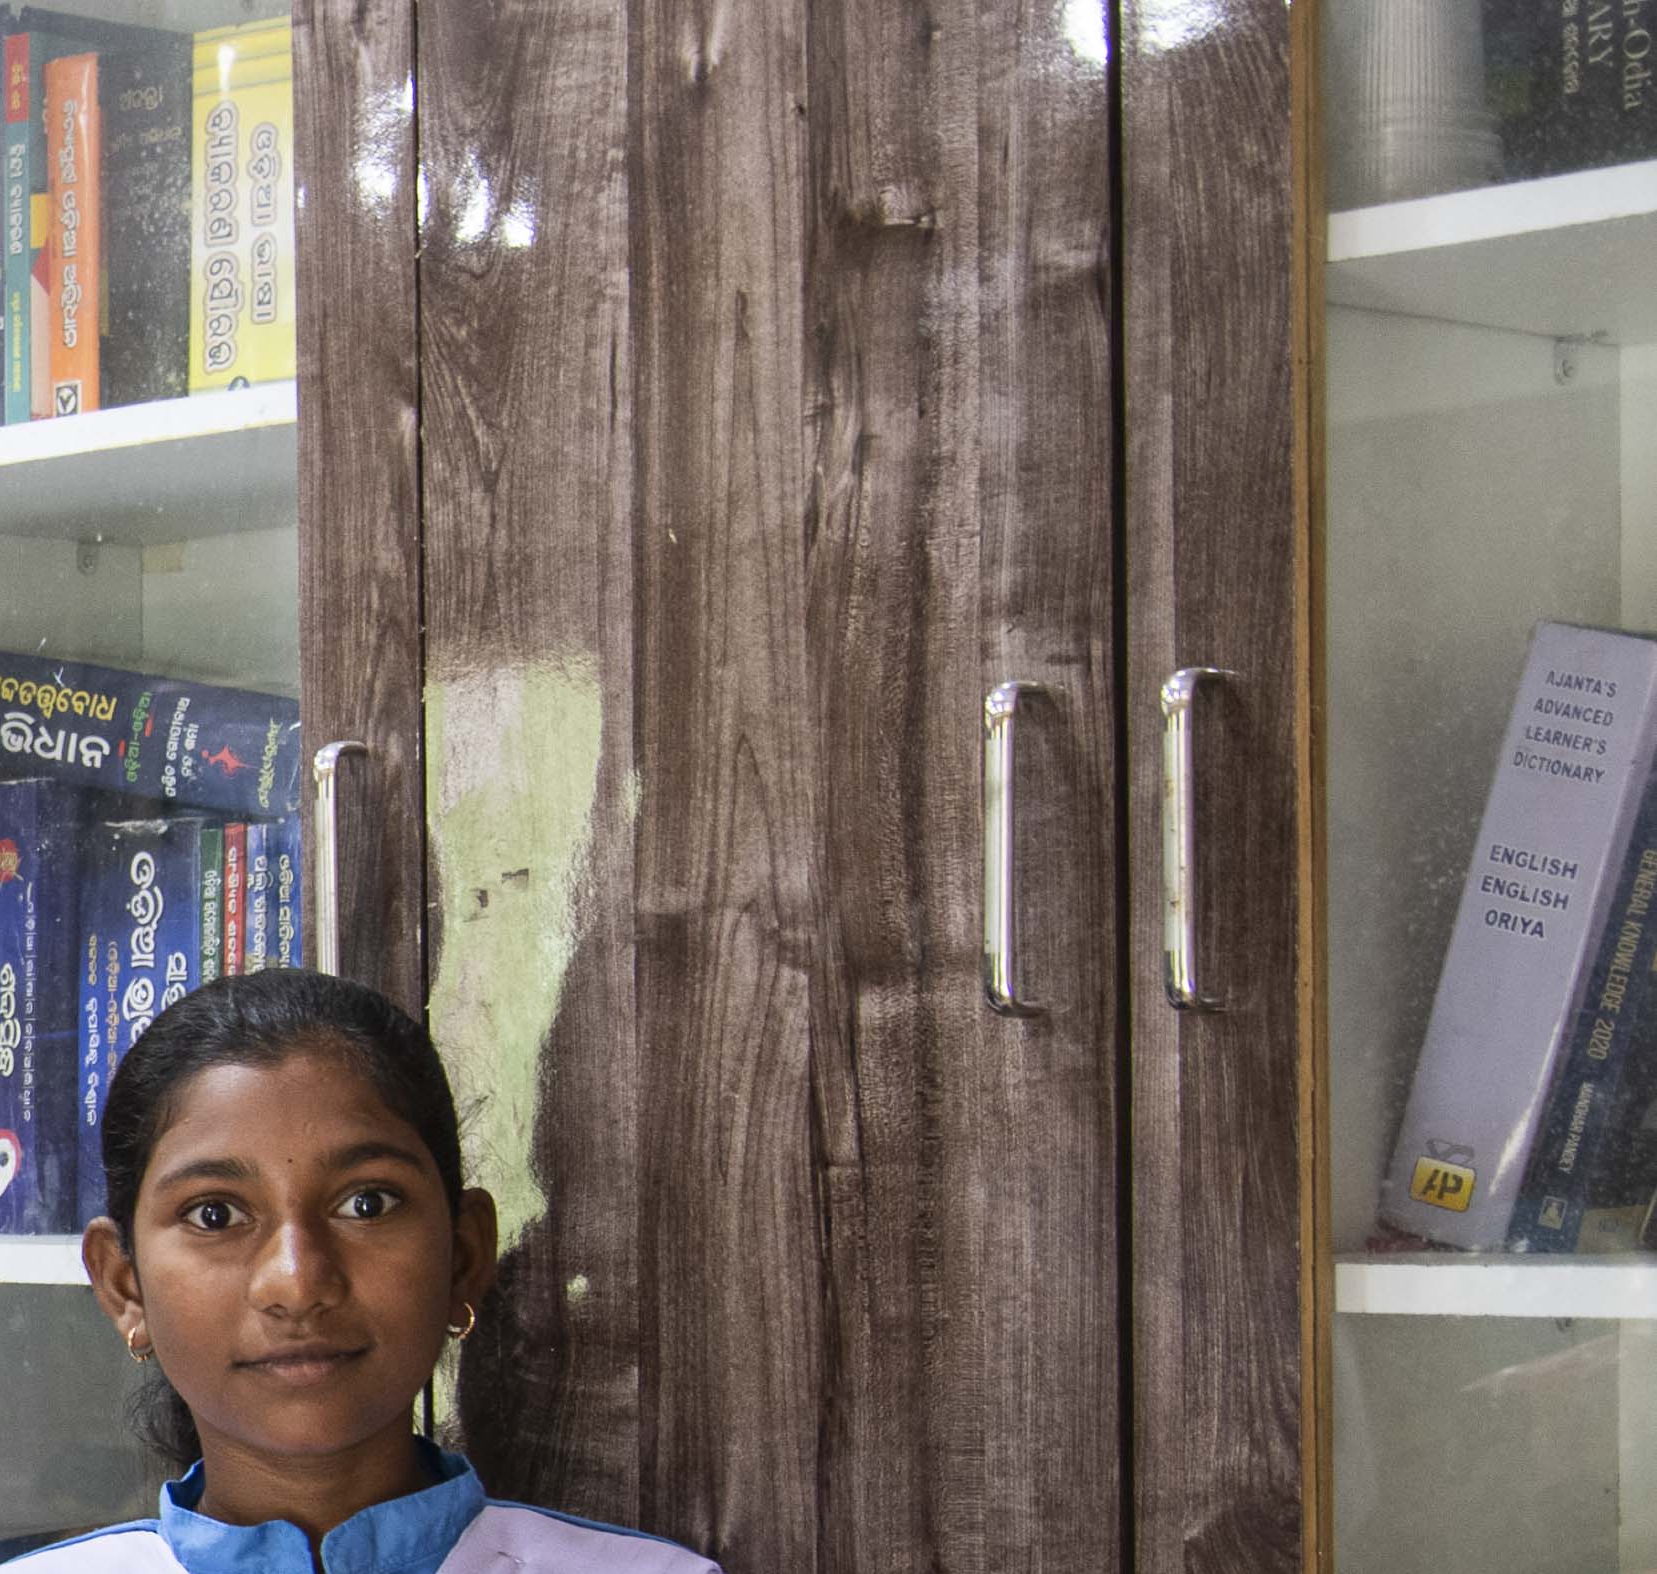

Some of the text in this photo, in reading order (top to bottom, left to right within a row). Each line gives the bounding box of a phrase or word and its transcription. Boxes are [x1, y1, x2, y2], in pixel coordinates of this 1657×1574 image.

[206, 106, 241, 368] ବ୍ୟାକରଣ ସୌରଭ
[253, 237, 275, 321] ଭାଷା
[1545, 669, 1618, 699] AJANTA'S
[1533, 698, 1614, 728] ADVANCED
[1524, 726, 1607, 755] LEARNER'S
[1513, 751, 1605, 784] DICTIONARY
[1489, 844, 1578, 881] ENGLISH
[126, 852, 162, 967] ଓଡ଼ିଆ
[1480, 875, 1569, 911] ENGLISH
[1484, 909, 1546, 940] ORIYA
[1588, 847, 1657, 1062] GENERAL KNOWLEDGE 2020
